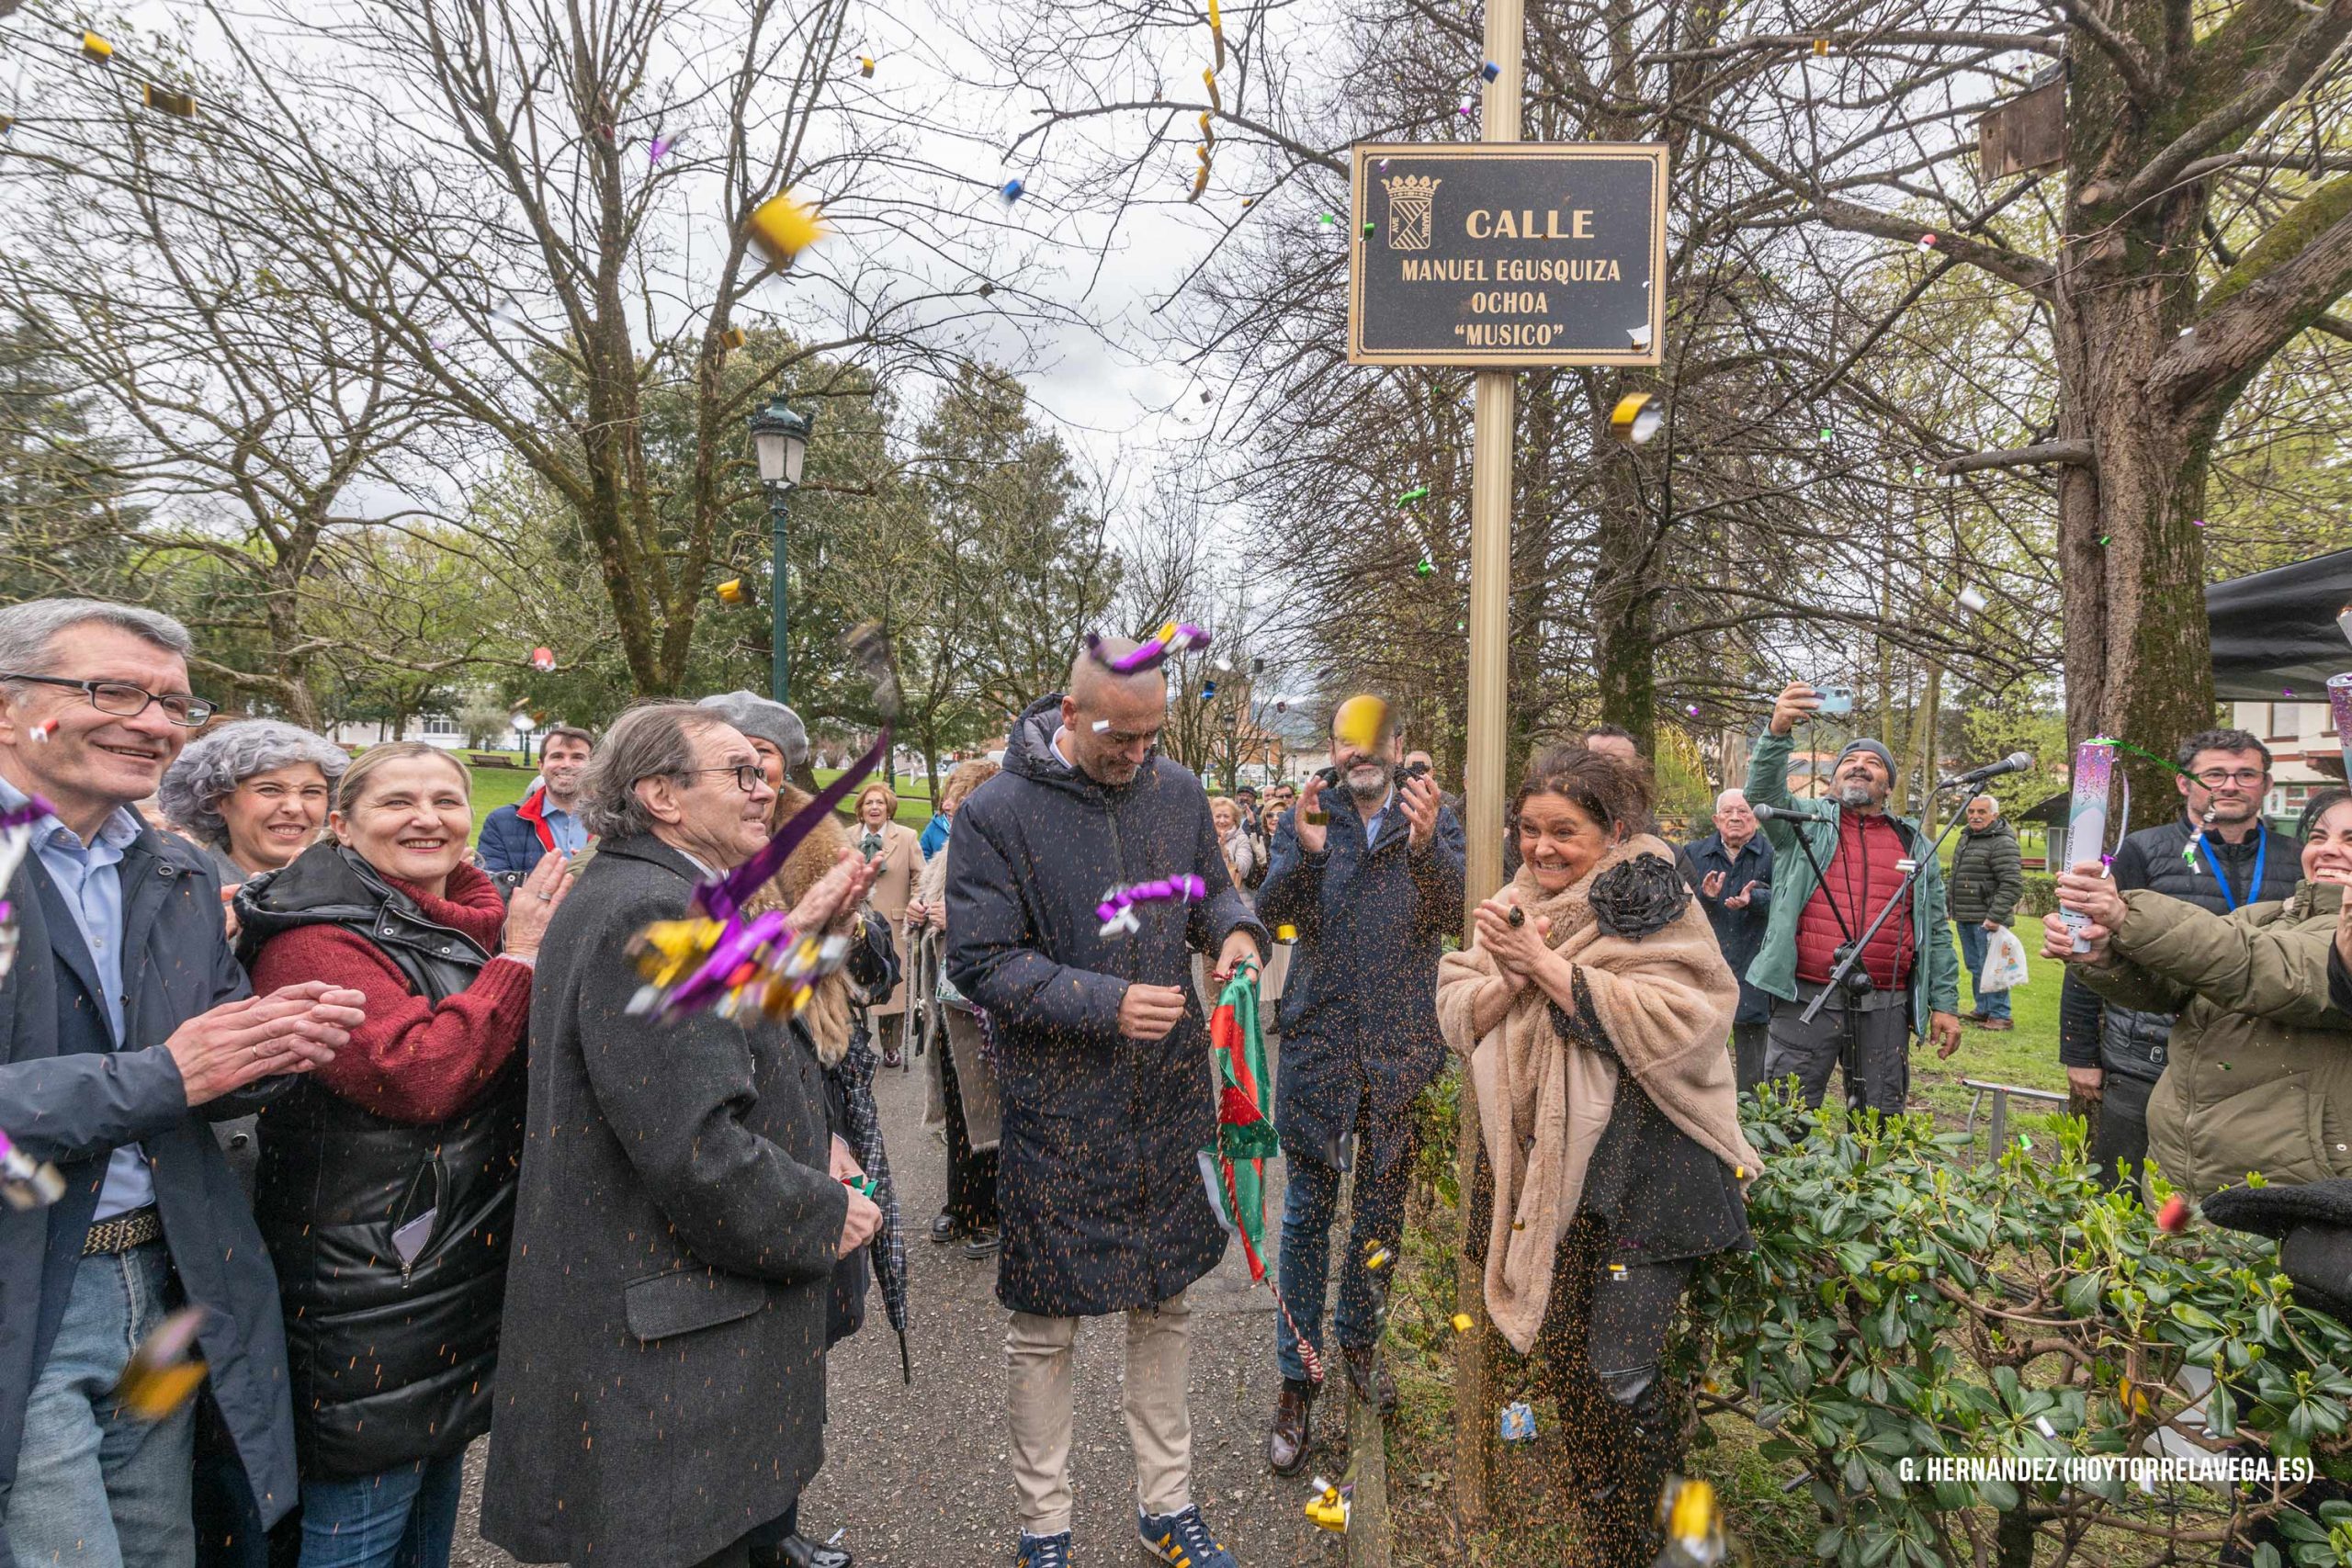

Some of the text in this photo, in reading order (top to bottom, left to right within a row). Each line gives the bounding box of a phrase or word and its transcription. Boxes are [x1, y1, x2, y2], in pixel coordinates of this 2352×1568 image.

[1466, 209, 1595, 239] CALLE
[1402, 259, 1621, 285] MANUEL EGUSQUIZA
[1472, 291, 1548, 313] OCHOA
